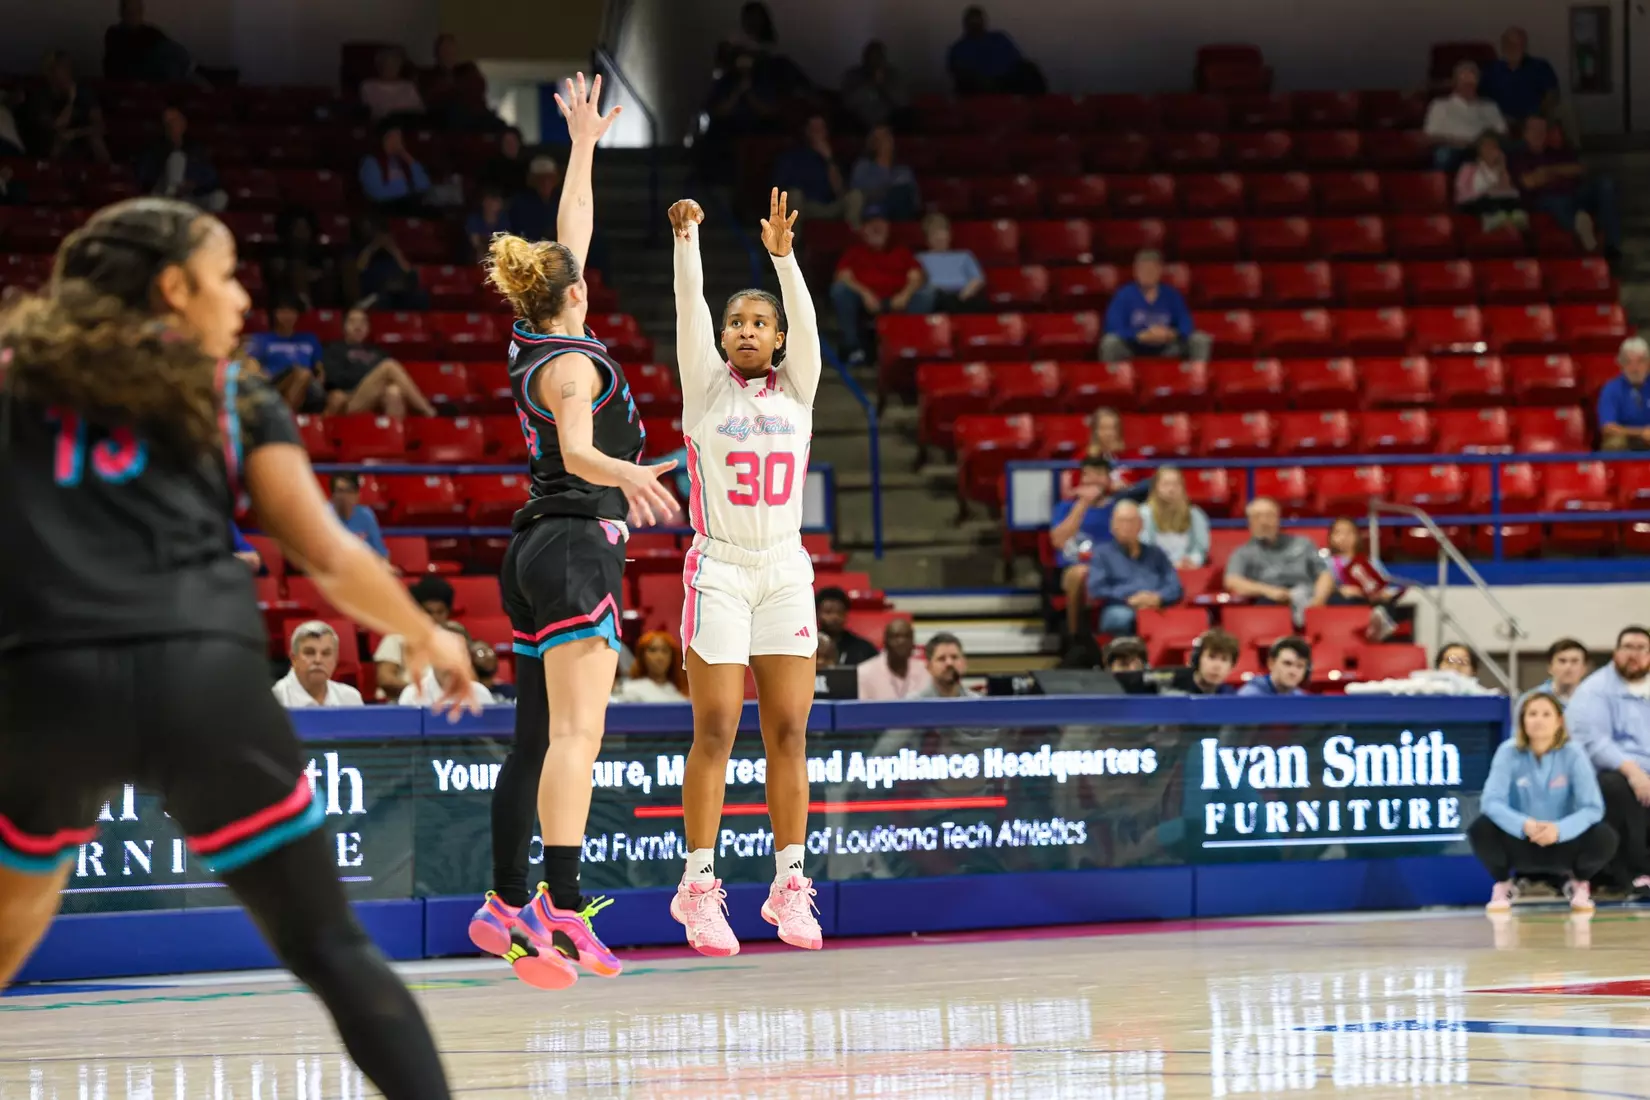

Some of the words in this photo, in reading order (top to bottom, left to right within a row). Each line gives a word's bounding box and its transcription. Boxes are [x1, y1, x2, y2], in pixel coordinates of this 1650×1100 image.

[716, 415, 751, 442] Lady
[725, 451, 795, 507] 30
[432, 759, 502, 791] Your
[806, 749, 843, 783] nd
[846, 748, 980, 788] Appliance
[983, 744, 1158, 784] Headquarters
[1200, 737, 1311, 790] Ivan
[1322, 729, 1463, 788] Smith
[1205, 796, 1461, 835] FURNITURE
[612, 829, 689, 861] Furnitu
[807, 826, 832, 855] of
[836, 824, 938, 855] Louisiana
[942, 821, 992, 850] Tech
[996, 817, 1088, 848] Athletics
